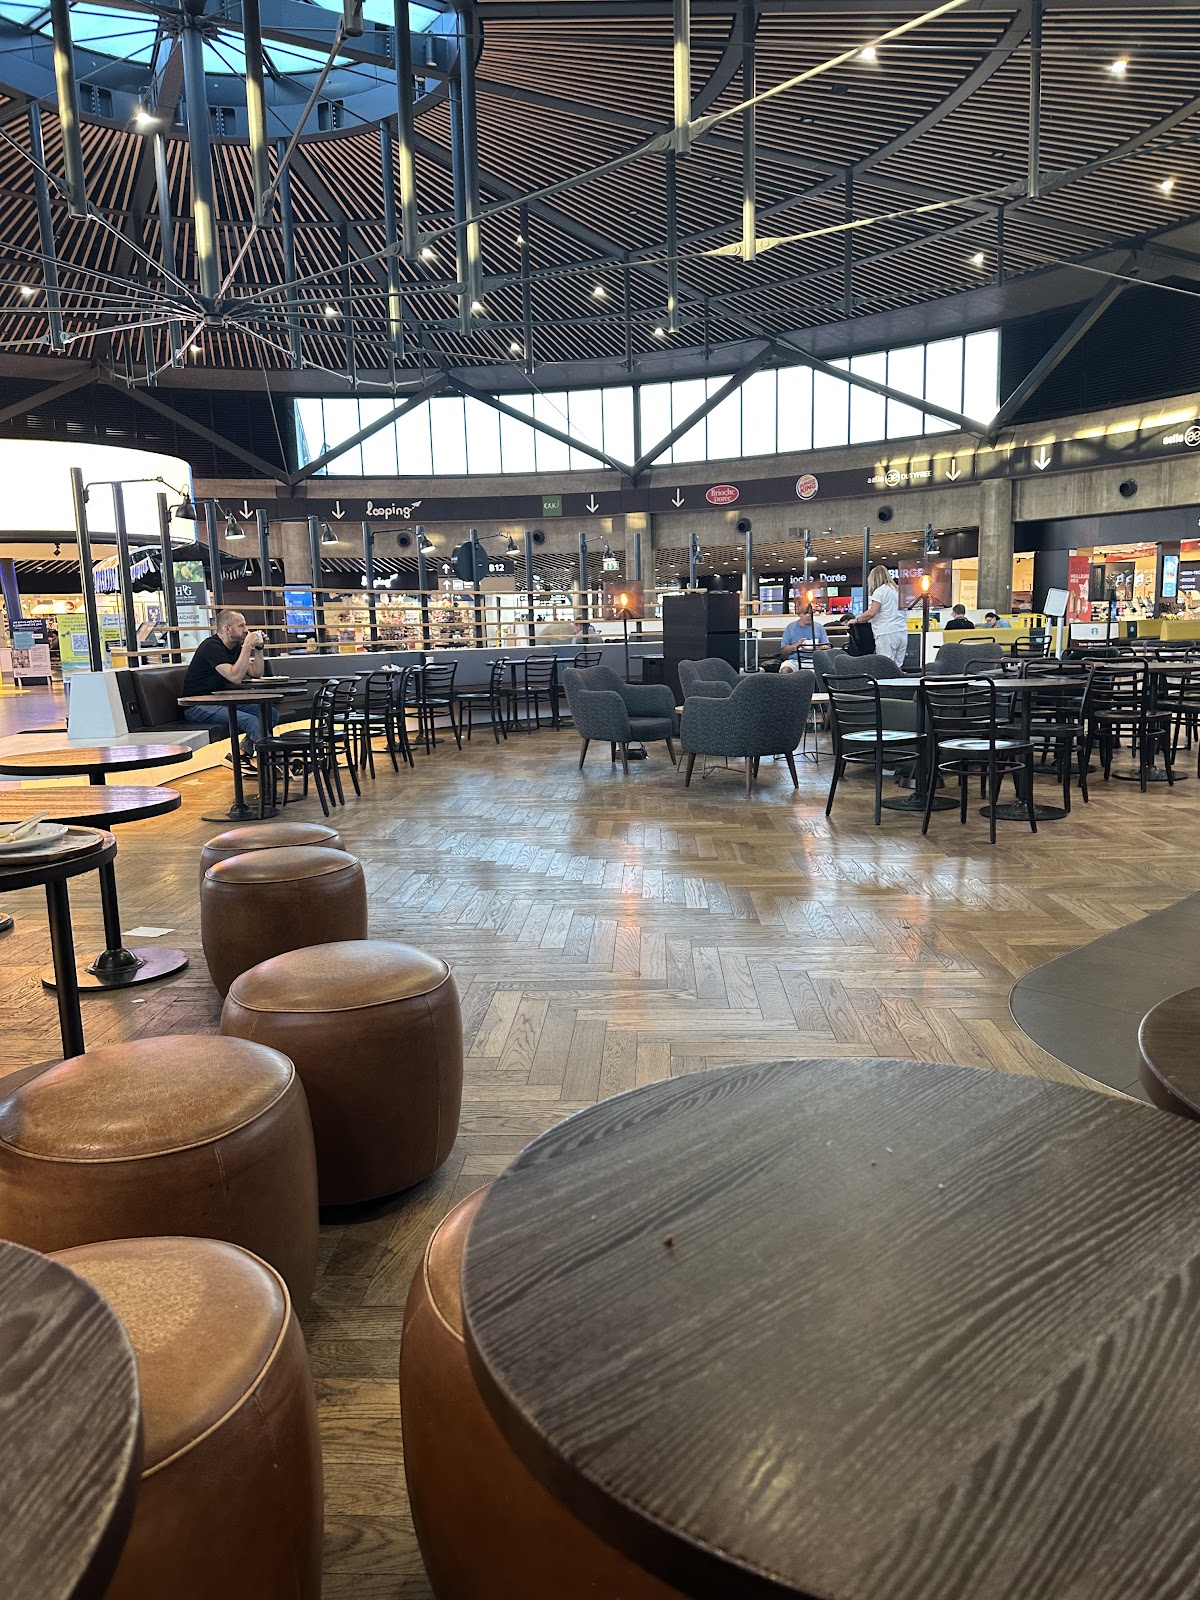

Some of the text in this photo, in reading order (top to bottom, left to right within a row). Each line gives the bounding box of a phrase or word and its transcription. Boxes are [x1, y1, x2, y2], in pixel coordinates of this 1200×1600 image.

[711, 488, 735, 497] Brioche
[800, 483, 817, 494] KING
[366, 501, 411, 519] looping
[488, 564, 505, 572] B12
[819, 573, 847, 583] Dorée
